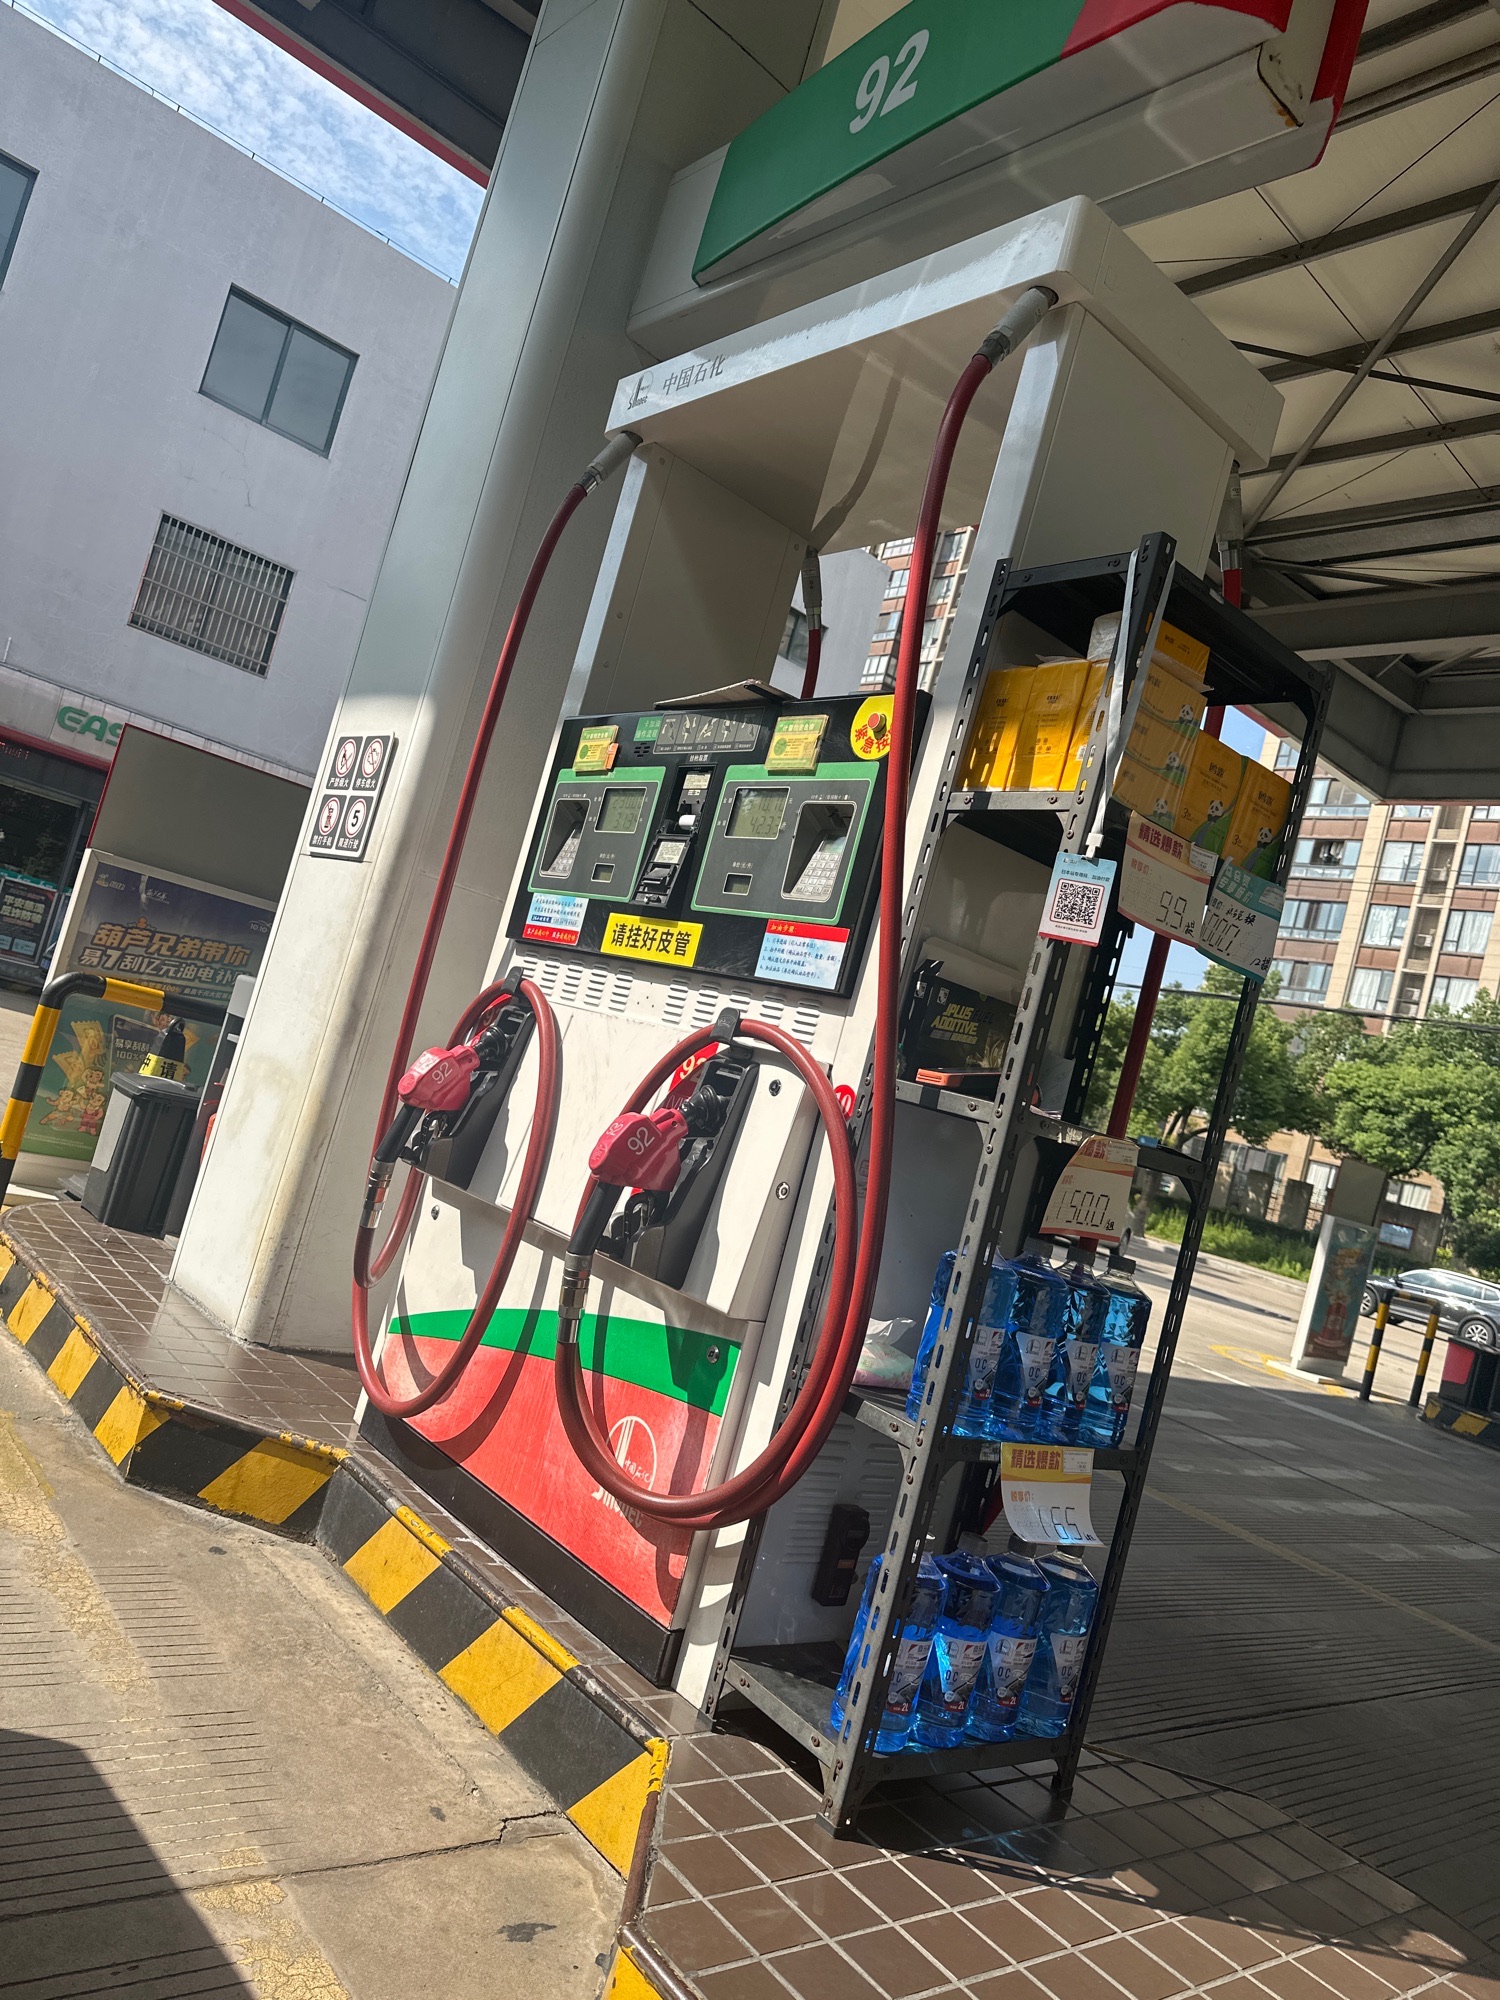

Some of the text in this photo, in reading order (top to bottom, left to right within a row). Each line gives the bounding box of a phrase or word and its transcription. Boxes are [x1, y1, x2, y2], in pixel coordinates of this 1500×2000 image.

[849, 29, 930, 134] 92
[663, 354, 726, 395] 中国石化
[854, 723, 893, 754] 紧急按
[351, 809, 360, 828] 5
[1138, 822, 1184, 860] 精选爆款
[92, 922, 251, 966] 葫芦兄弟带你
[611, 923, 692, 957] 请挂好皮管
[930, 1015, 979, 1035] ADDITIVE
[432, 1061, 453, 1084] 92
[627, 1126, 655, 1156] 92
[1011, 1449, 1060, 1470] 精选爆款
